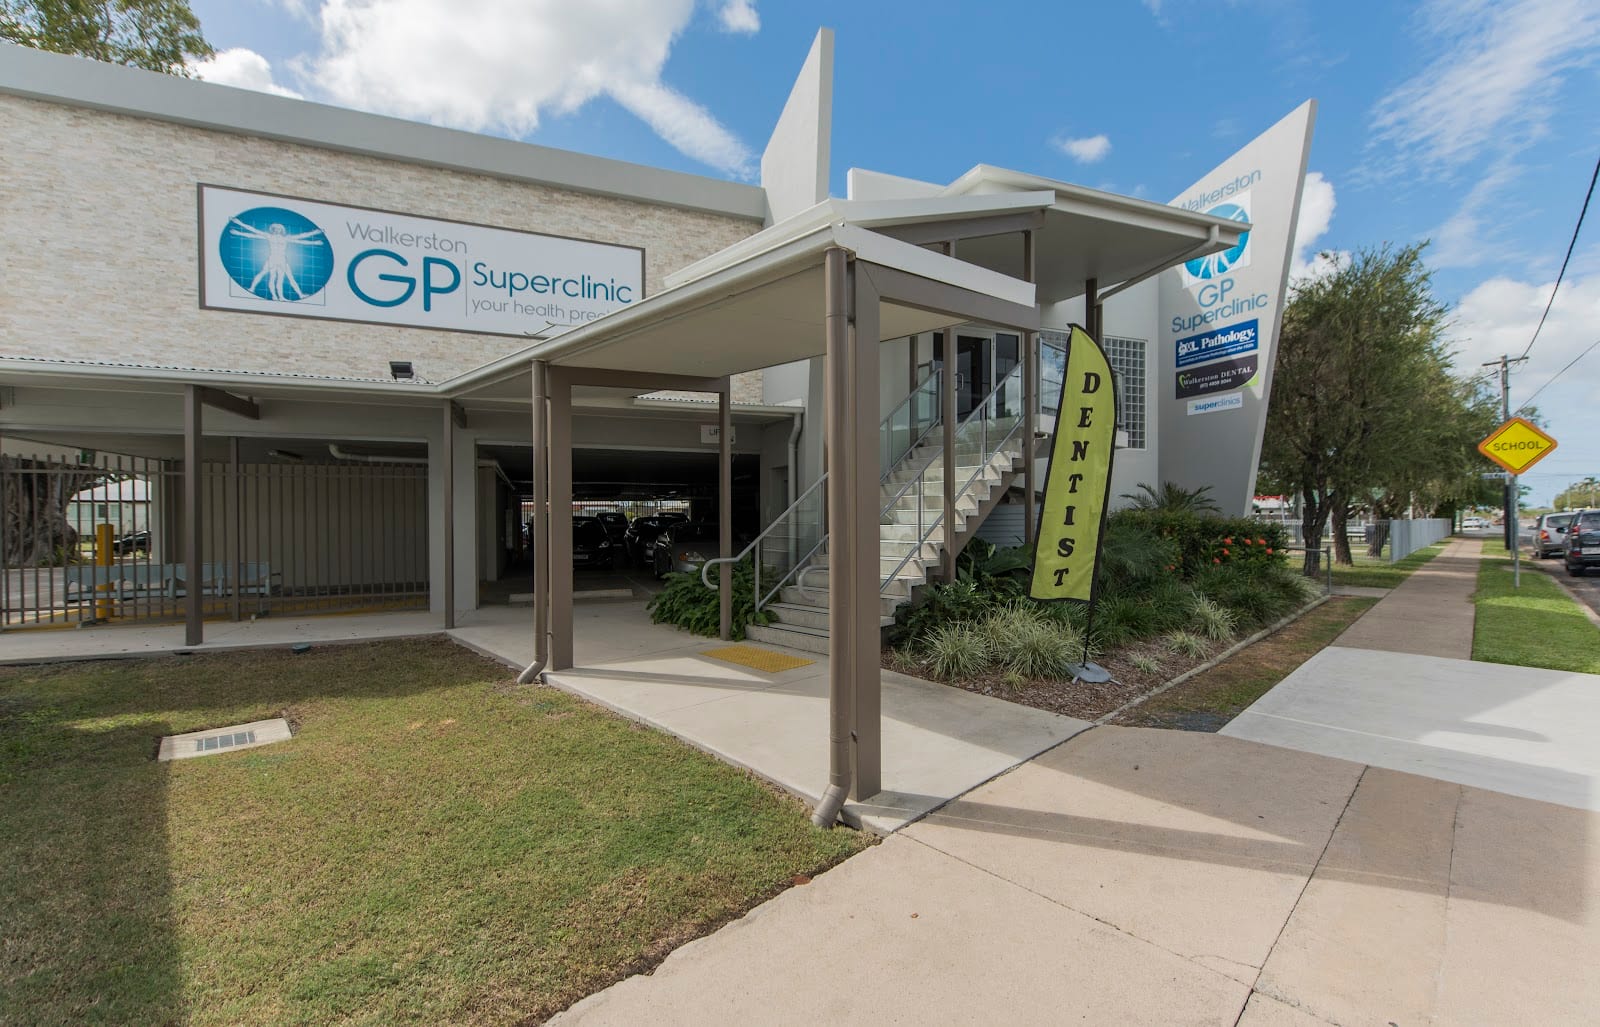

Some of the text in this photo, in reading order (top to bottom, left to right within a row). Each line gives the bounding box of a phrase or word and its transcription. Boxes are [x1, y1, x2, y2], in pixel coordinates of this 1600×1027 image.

[346, 221, 468, 254] Walkerston
[346, 248, 461, 312] GP
[473, 262, 632, 304] Superclinic
[1198, 278, 1234, 308] GP
[471, 298, 509, 314] your
[513, 300, 565, 319] health
[1172, 293, 1268, 333] Superclinic
[1184, 366, 1252, 386] Walkerston DENTAL
[1194, 397, 1241, 411] superclinics
[1493, 440, 1544, 451] SCHOOL
[1053, 371, 1101, 587] DENTIST
